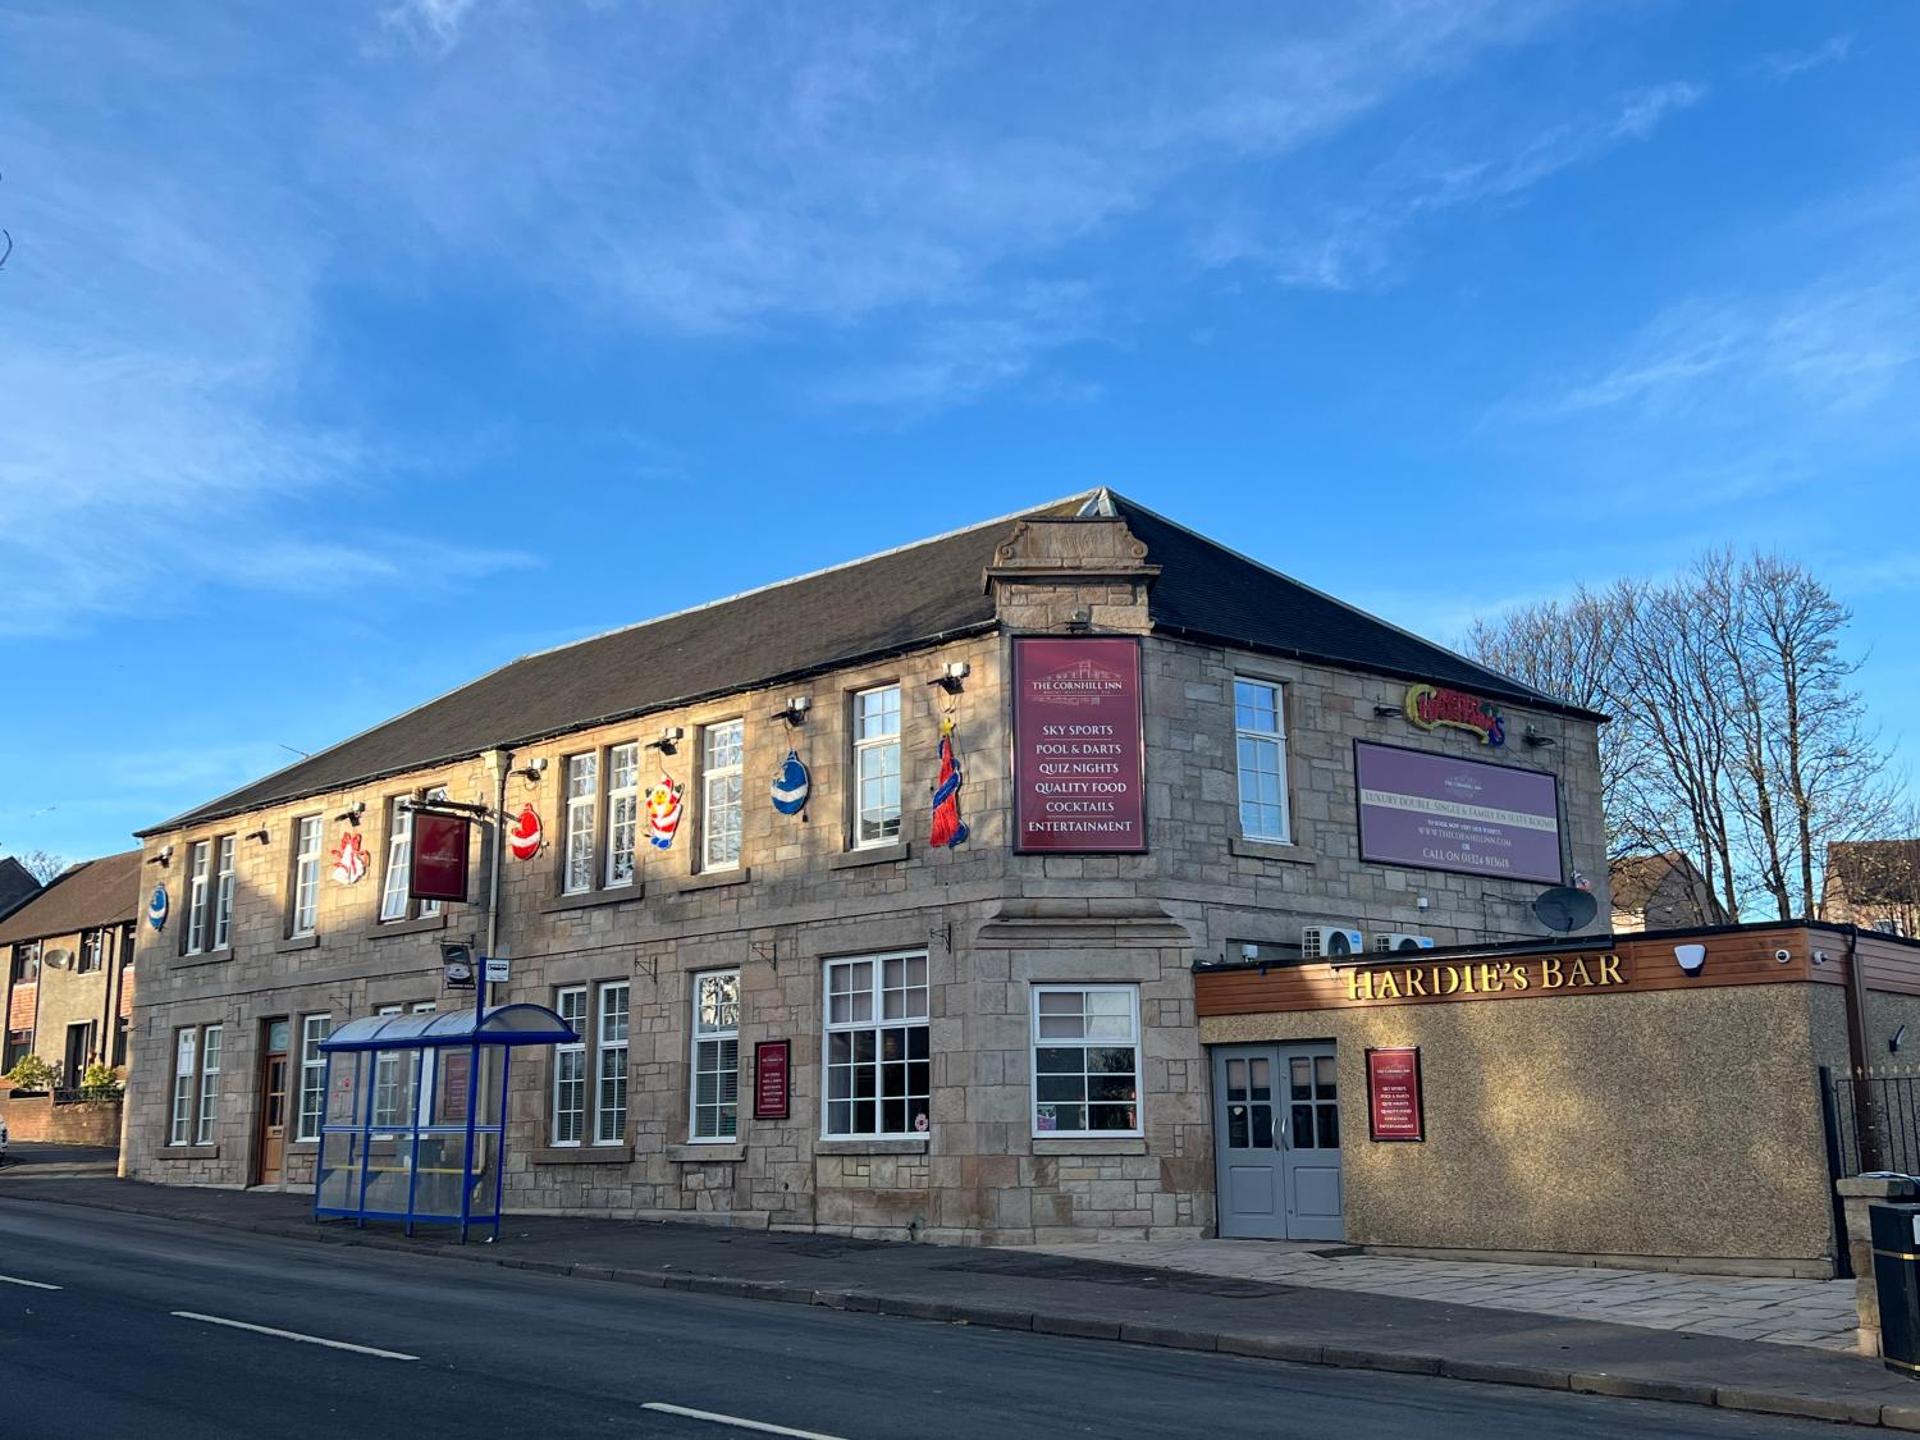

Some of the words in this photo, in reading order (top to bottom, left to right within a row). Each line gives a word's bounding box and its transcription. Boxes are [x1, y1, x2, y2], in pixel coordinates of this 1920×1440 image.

[1032, 681, 1051, 690] THE
[1053, 681, 1103, 690] CORNHILL
[1105, 681, 1122, 690] INN
[1042, 725, 1066, 736] SKY
[1069, 725, 1113, 736] SPORTS
[1036, 744, 1069, 755] POOL
[1071, 744, 1080, 755] &
[1083, 744, 1121, 755] DARTS
[1039, 763, 1070, 774] QUIZ
[1073, 763, 1119, 774] NIGHTS
[1035, 782, 1089, 794] QUALITY
[1092, 782, 1127, 794] FOOD
[1046, 801, 1114, 812] COCKTAILS
[1028, 821, 1132, 832] ENTERTAINMENT
[1422, 847, 1445, 860] CALL
[1446, 850, 1460, 862] ON
[1349, 960, 1530, 1000] HARDIE's
[1541, 954, 1628, 989] BAR
